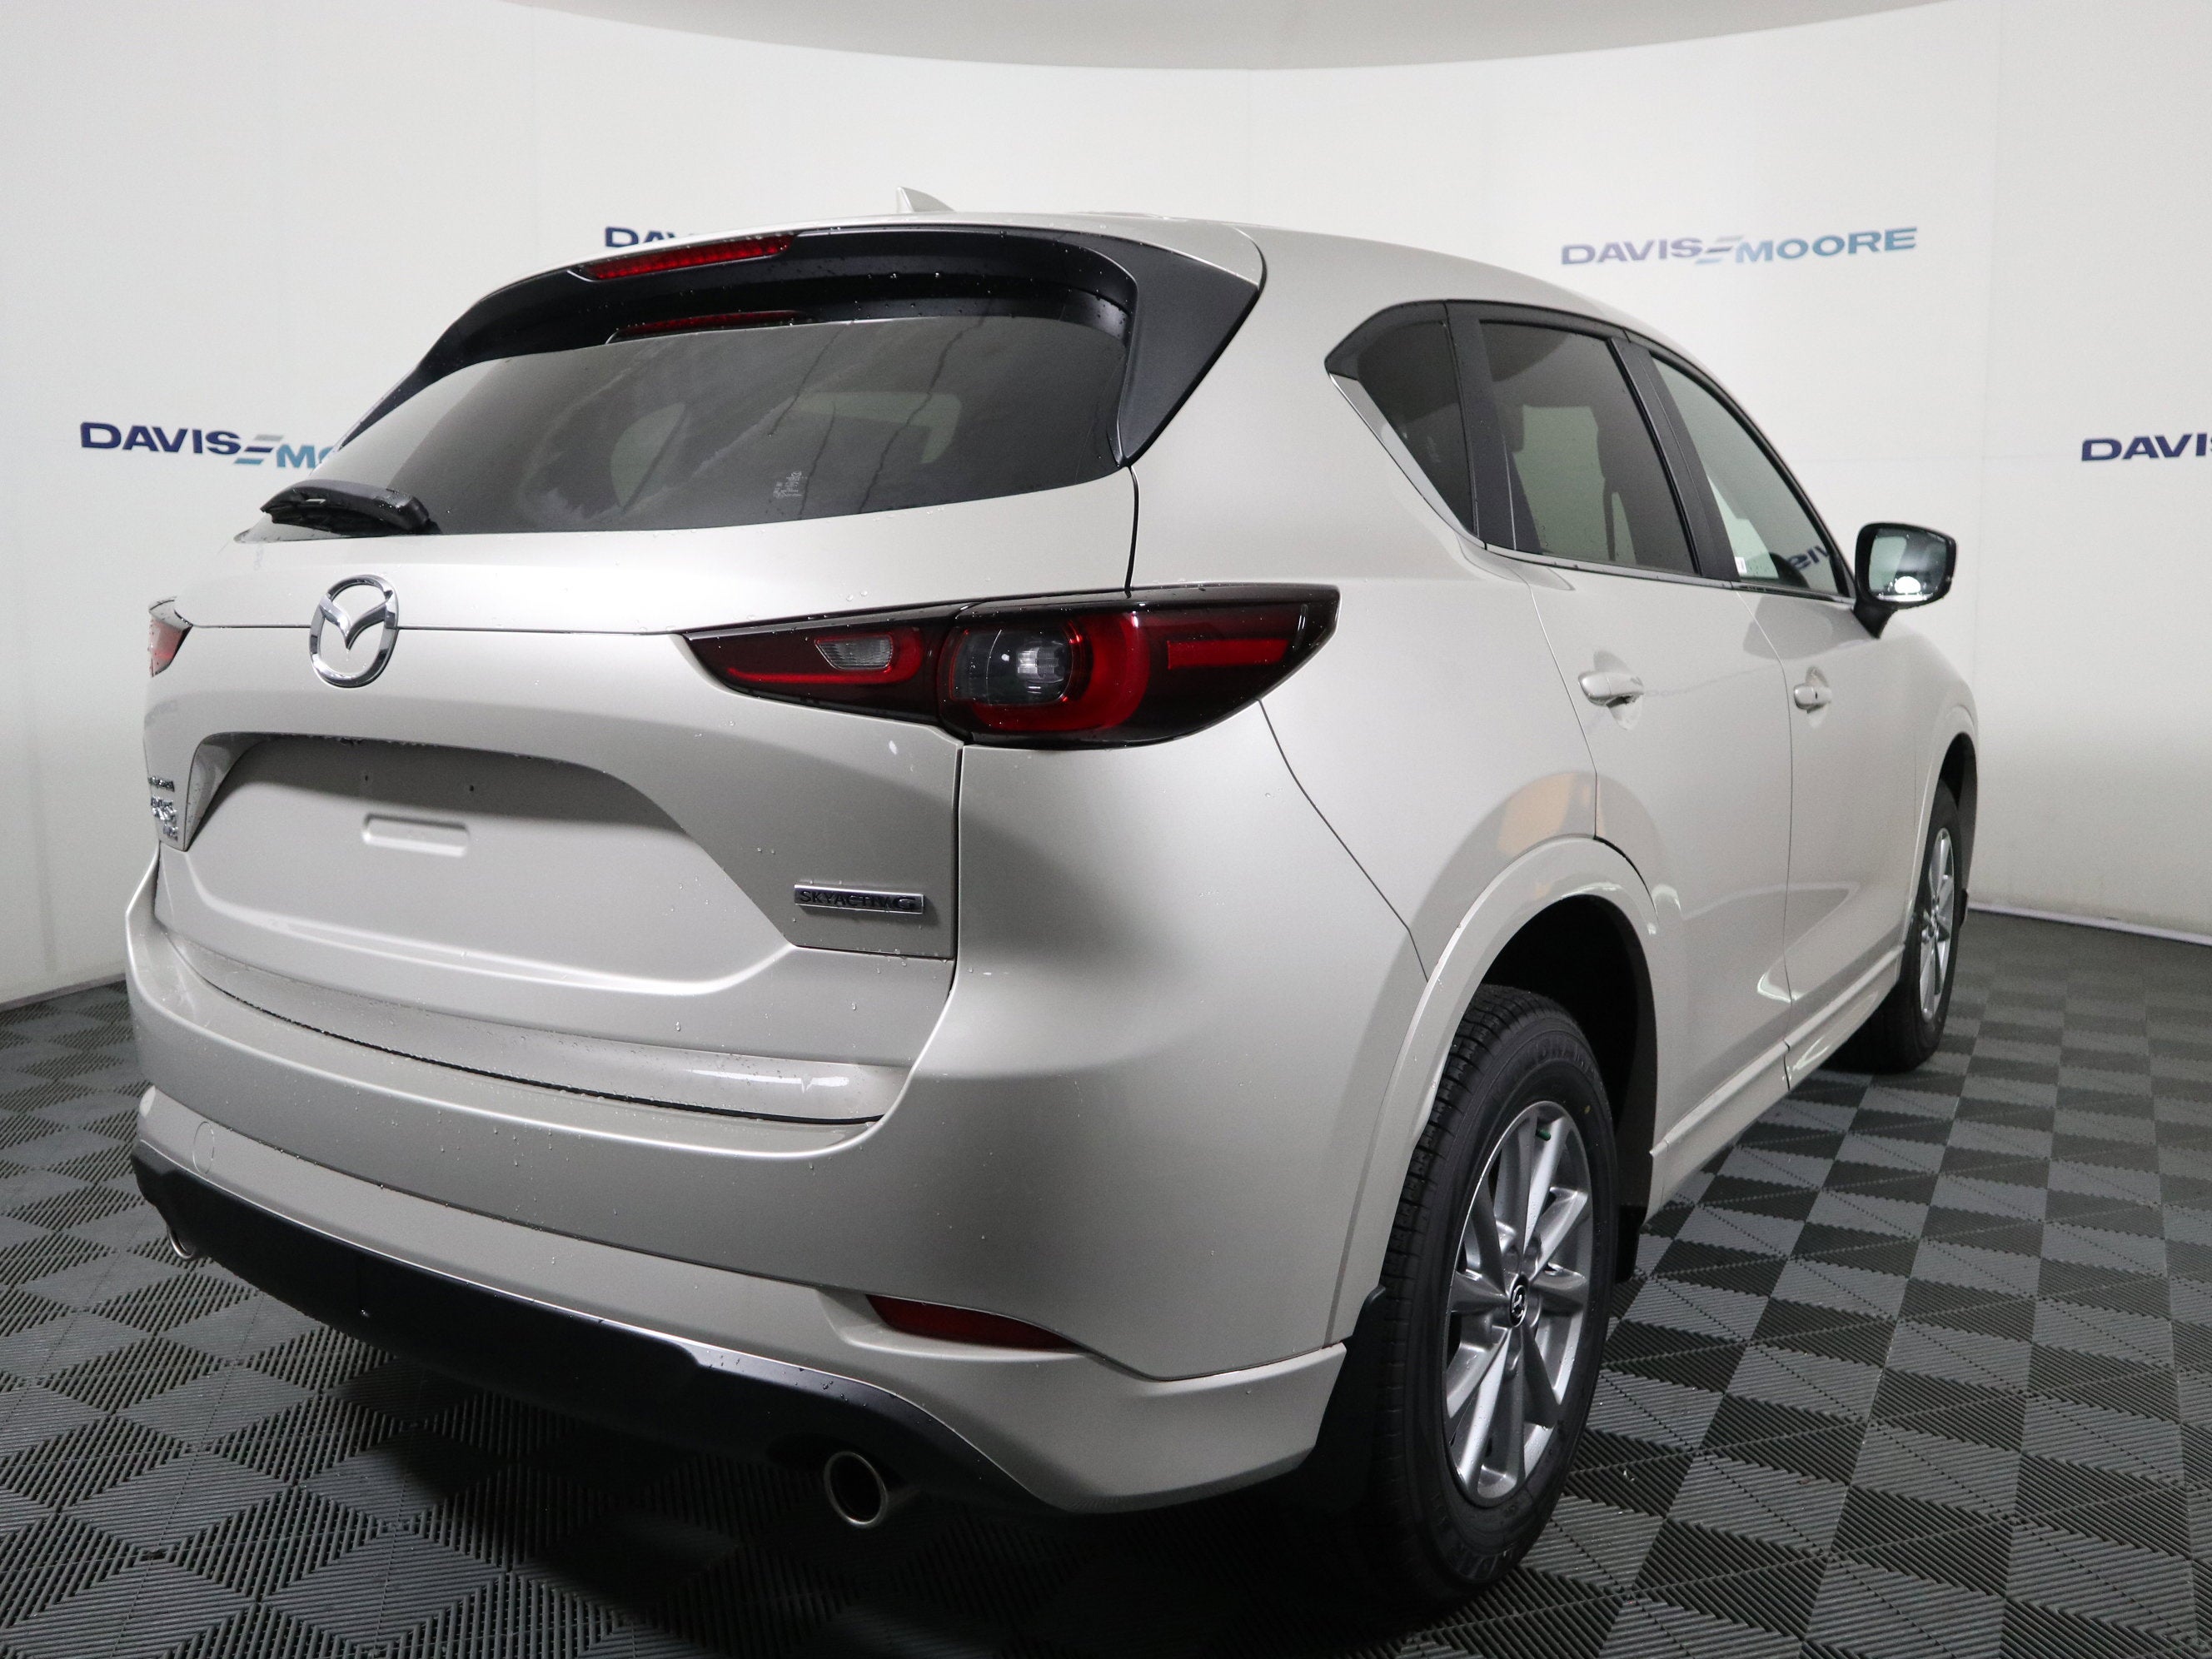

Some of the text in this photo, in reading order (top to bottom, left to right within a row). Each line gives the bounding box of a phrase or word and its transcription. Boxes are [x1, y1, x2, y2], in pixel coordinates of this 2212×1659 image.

[605, 227, 675, 247] DA
[1562, 227, 1917, 265] DAVIS MOORE
[80, 421, 242, 455] DAVIS
[2081, 432, 2212, 461] DAVI
